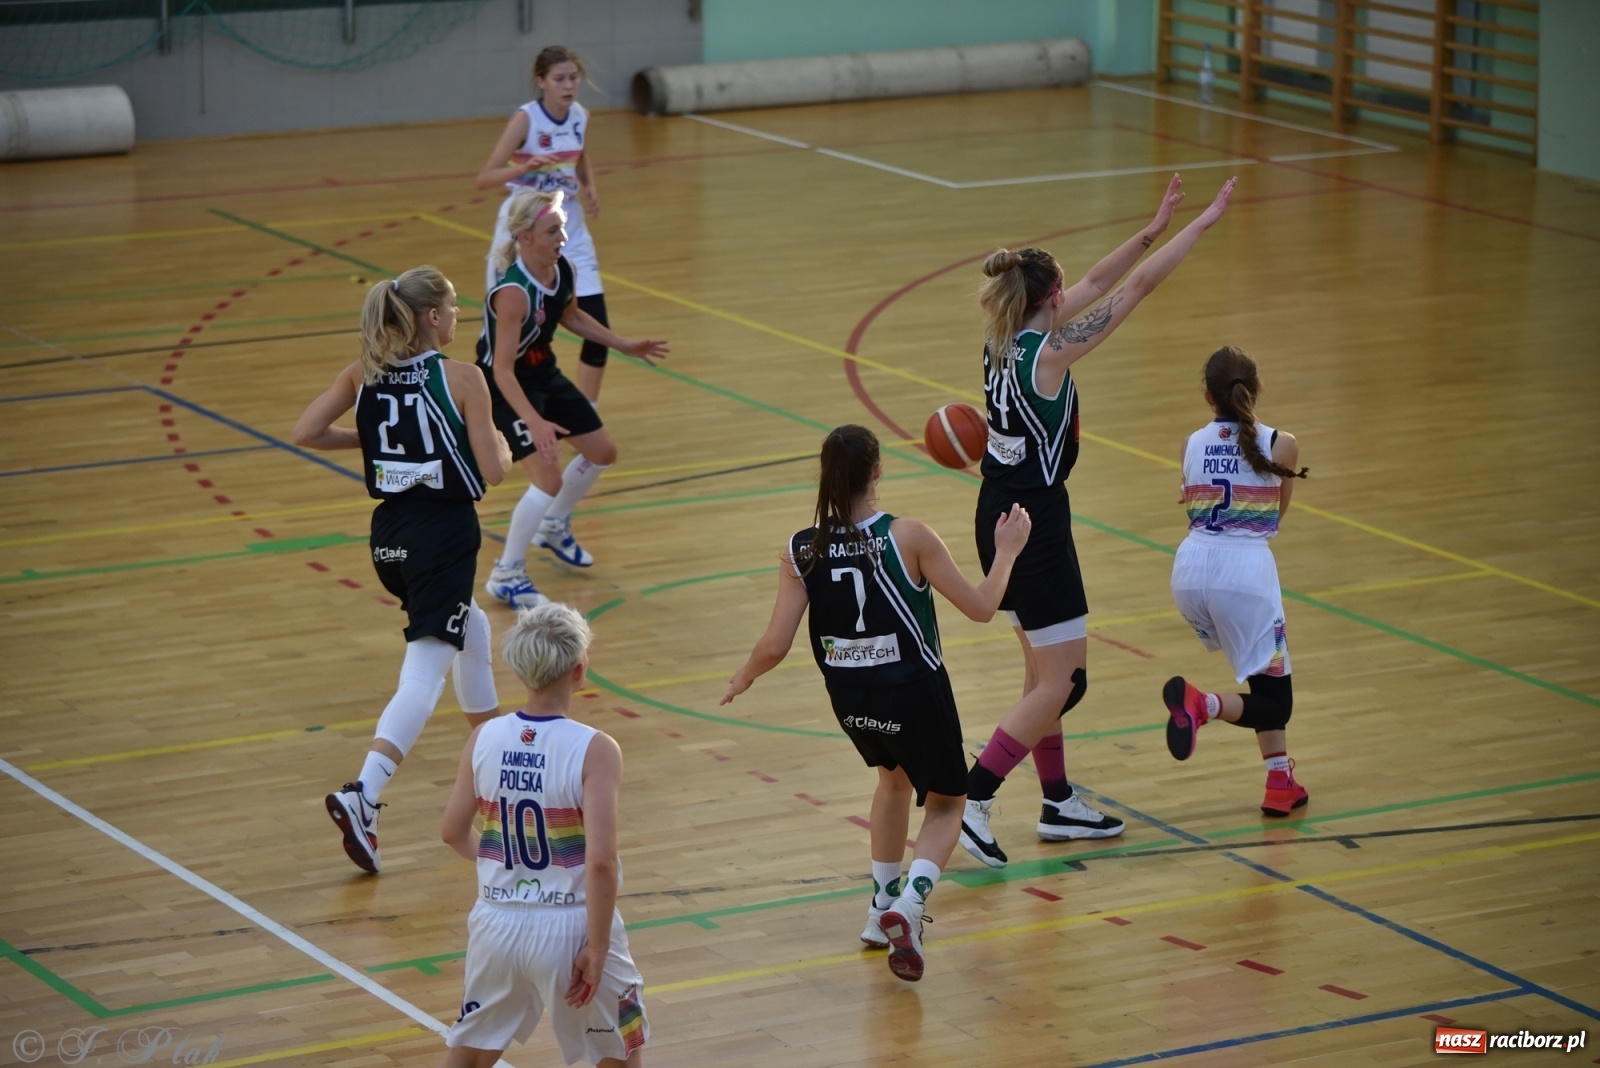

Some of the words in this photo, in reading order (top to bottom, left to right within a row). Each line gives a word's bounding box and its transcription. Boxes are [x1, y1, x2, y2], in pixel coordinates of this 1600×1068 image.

[376, 392, 435, 455] 27
[512, 418, 534, 447] 5
[1204, 444, 1241, 457] KAMIENICA
[1203, 458, 1240, 475] POLSKA
[1205, 478, 1231, 531] 2
[830, 567, 867, 633] 7
[502, 750, 546, 770] KAMIENICA
[500, 769, 544, 793] POLSKA
[500, 796, 551, 872] 10
